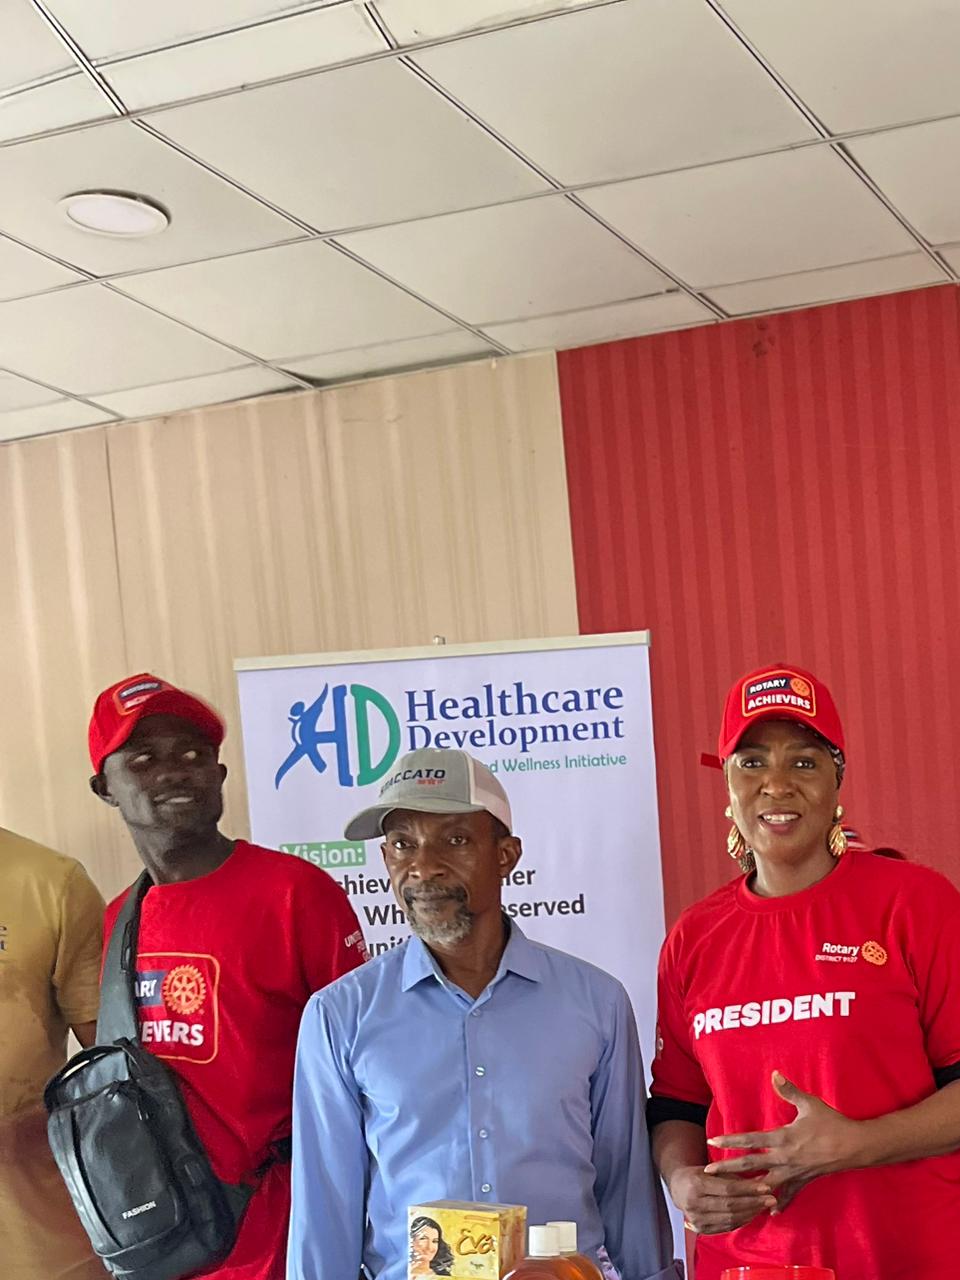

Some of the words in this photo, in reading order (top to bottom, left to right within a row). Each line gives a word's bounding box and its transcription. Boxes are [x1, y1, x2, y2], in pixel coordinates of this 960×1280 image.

[749, 677, 788, 694] ROTARY
[405, 682, 624, 722] Healthcare
[747, 694, 811, 711] ACHIEVERS
[407, 715, 625, 753] Development
[503, 757, 560, 772] Wellness
[565, 753, 627, 768] Initiative
[822, 942, 860, 957] Rotary
[693, 991, 856, 1039] PRESIDENT
[122, 1201, 156, 1219] FASHION
[456, 1227, 497, 1257] Eva
